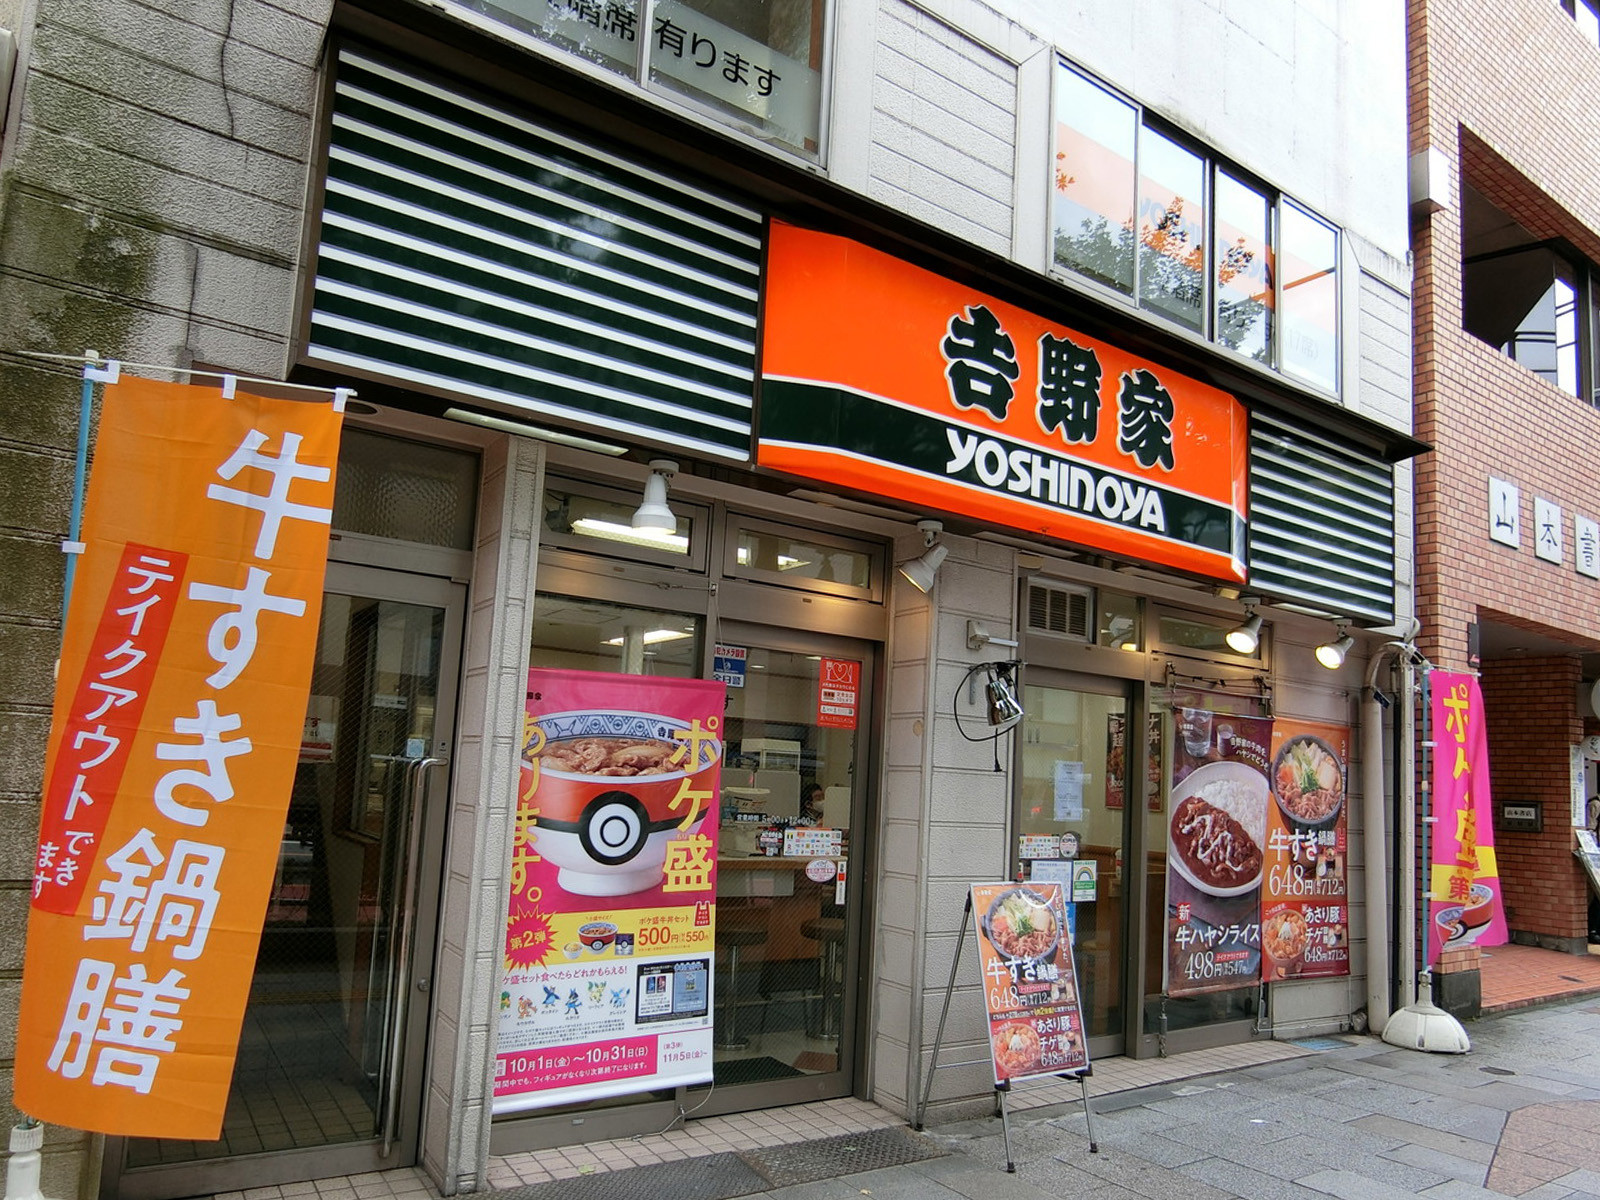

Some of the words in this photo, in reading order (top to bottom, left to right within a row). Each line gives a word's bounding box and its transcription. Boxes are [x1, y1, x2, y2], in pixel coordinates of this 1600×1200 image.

[654, 16, 782, 97] 有ります
[939, 304, 1176, 474] 吉野家
[945, 427, 1166, 532] YOSHINOYA
[64, 555, 174, 821] テイクアウト
[47, 428, 333, 1095] 牛すき鍋膳
[663, 716, 719, 893] ポケ盛
[509, 930, 546, 951] 第2弾
[638, 926, 679, 946] 500円
[1175, 924, 1260, 951] 牛ハヤシライス
[1179, 904, 1191, 921] 新
[1184, 951, 1222, 979] 498円
